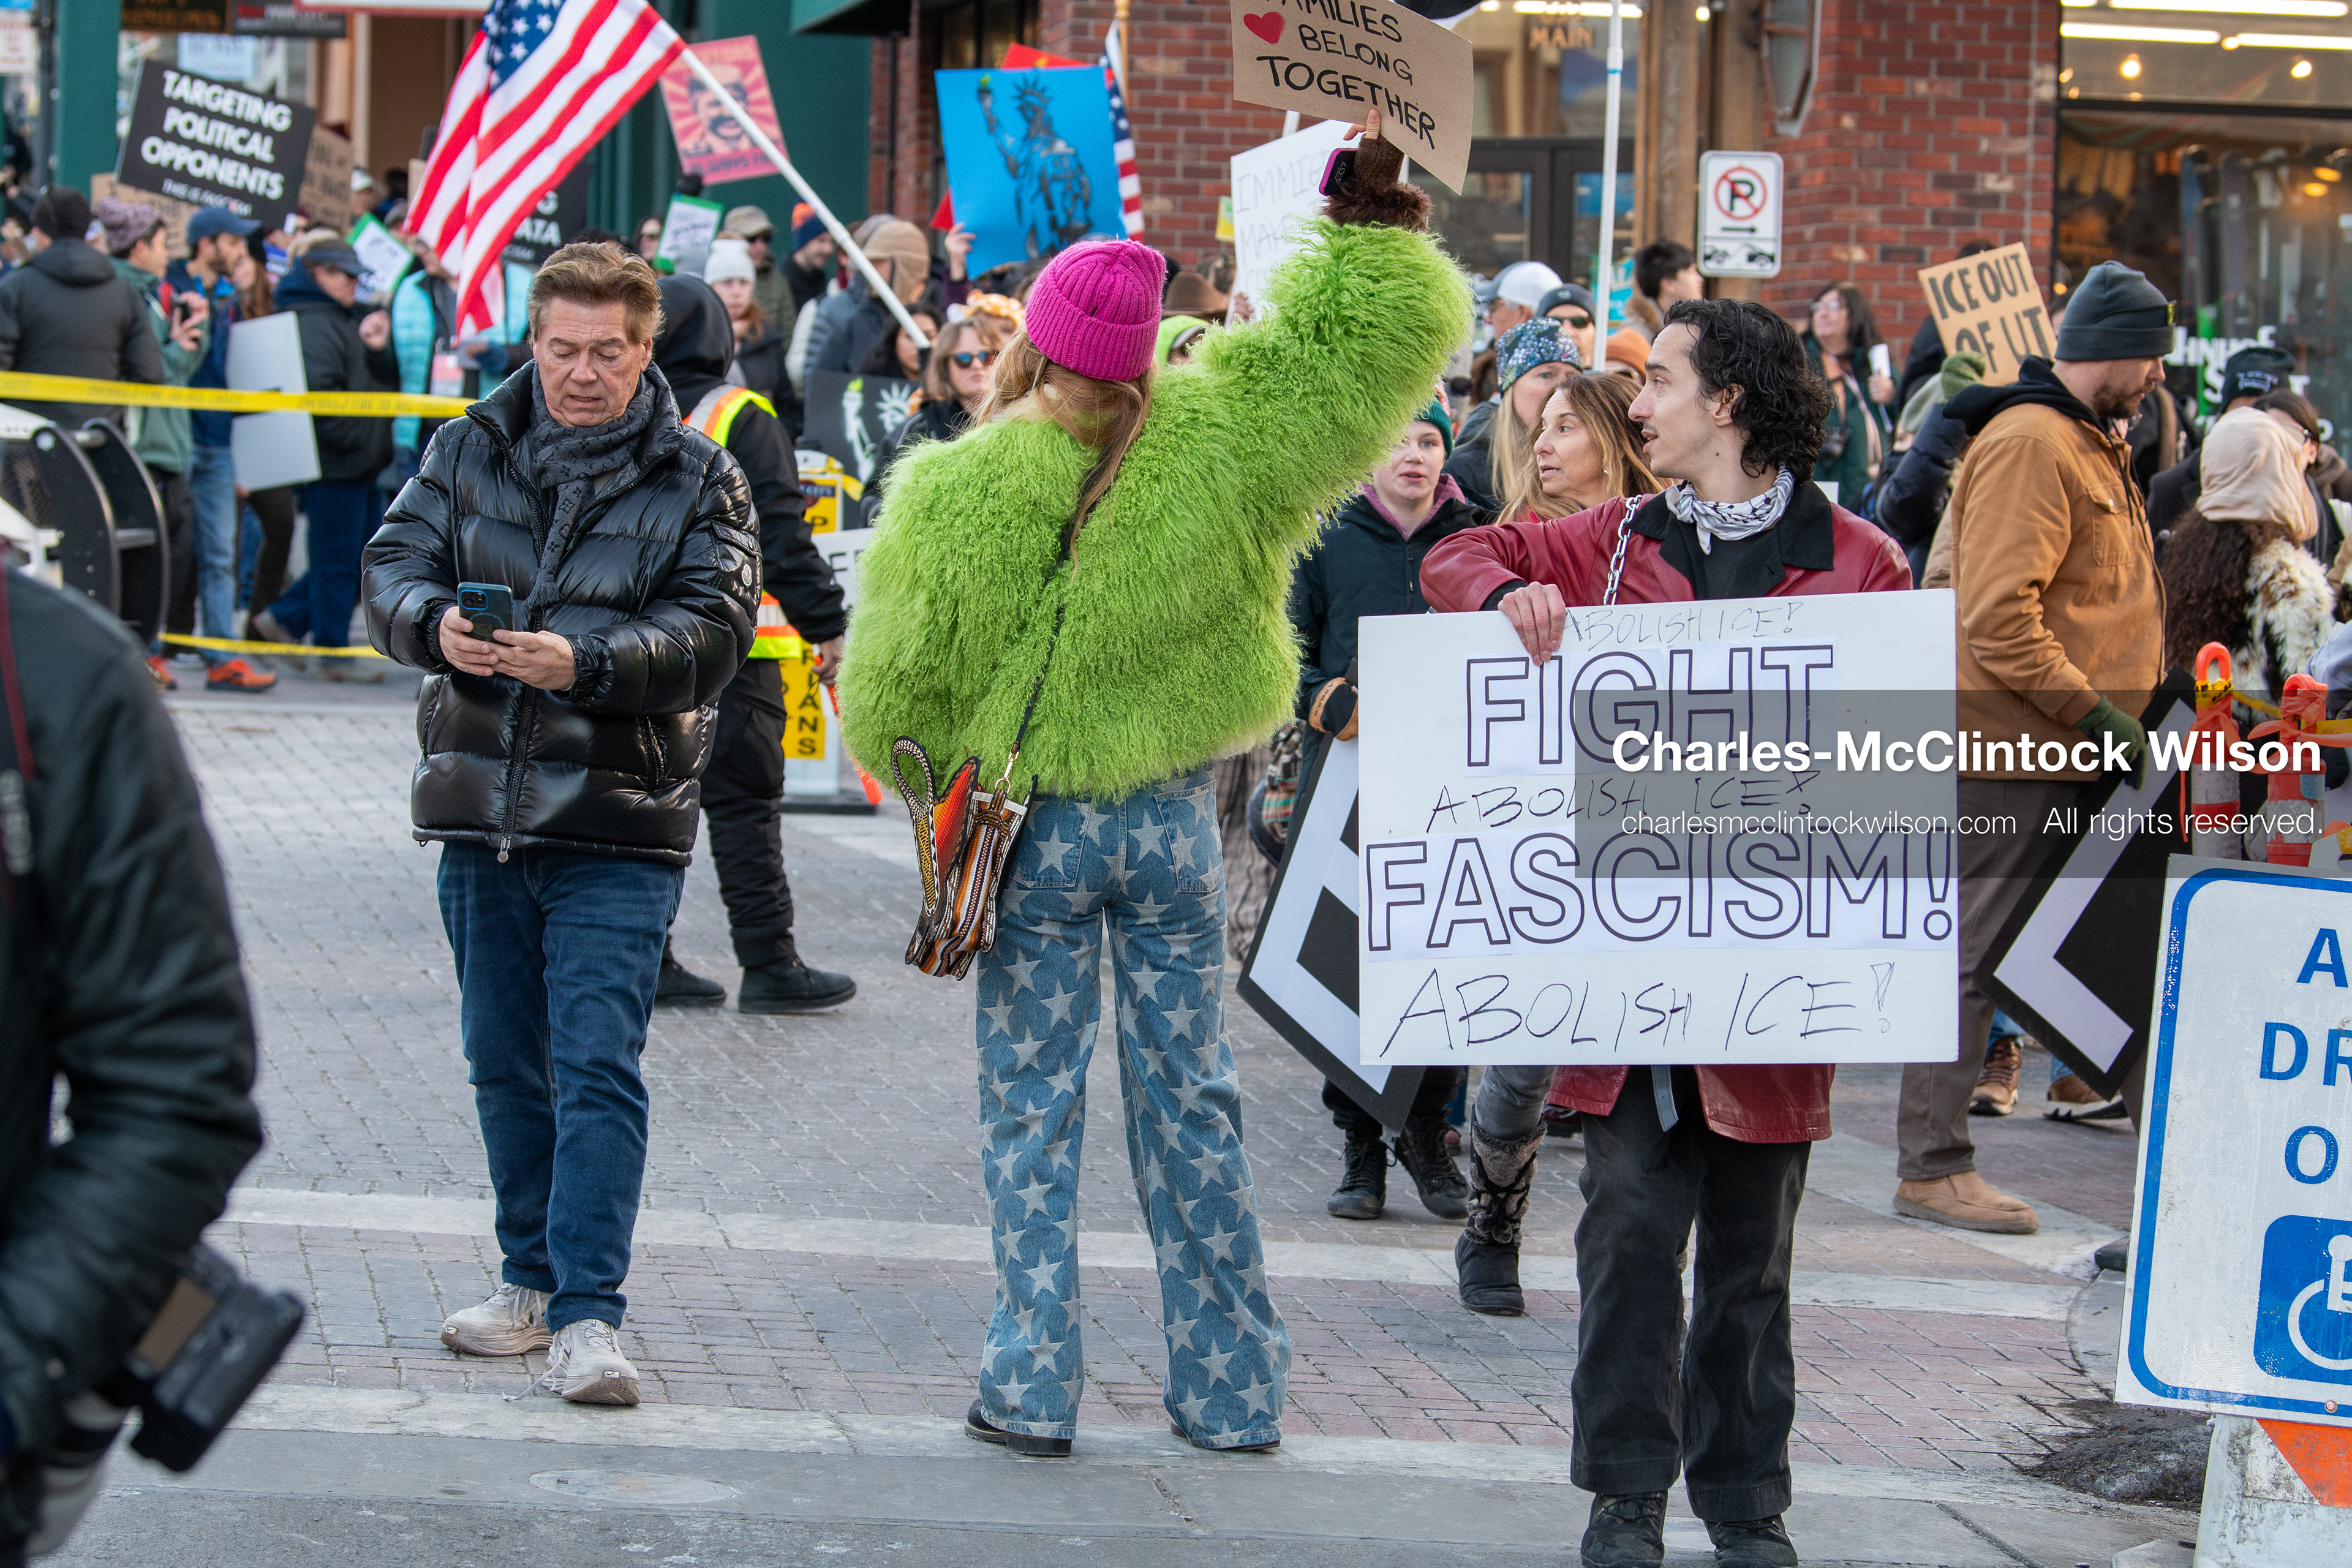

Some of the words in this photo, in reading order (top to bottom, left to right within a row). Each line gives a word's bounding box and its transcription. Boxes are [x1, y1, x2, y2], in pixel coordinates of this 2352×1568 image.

[1266, 0, 1402, 43] MILIES
[1529, 26, 1594, 50] MAIN
[1298, 23, 1413, 86] BELONG
[162, 69, 293, 132] TARGETING
[1256, 56, 1436, 150] TOGETHER
[162, 106, 275, 164] POLITICAL
[140, 135, 285, 200] OPPONENTS
[1335, 161, 1347, 184] 4:07
[1928, 267, 1981, 320] ICE
[1977, 252, 2030, 303] OUT
[1999, 304, 2053, 367] UT
[1562, 608, 1702, 650] ABOLISH
[1466, 644, 1834, 767] FIGHT
[1426, 777, 1648, 834] ABOLISH
[1366, 826, 1953, 952] FASCISM!
[1379, 967, 1692, 1058] ABOLISH
